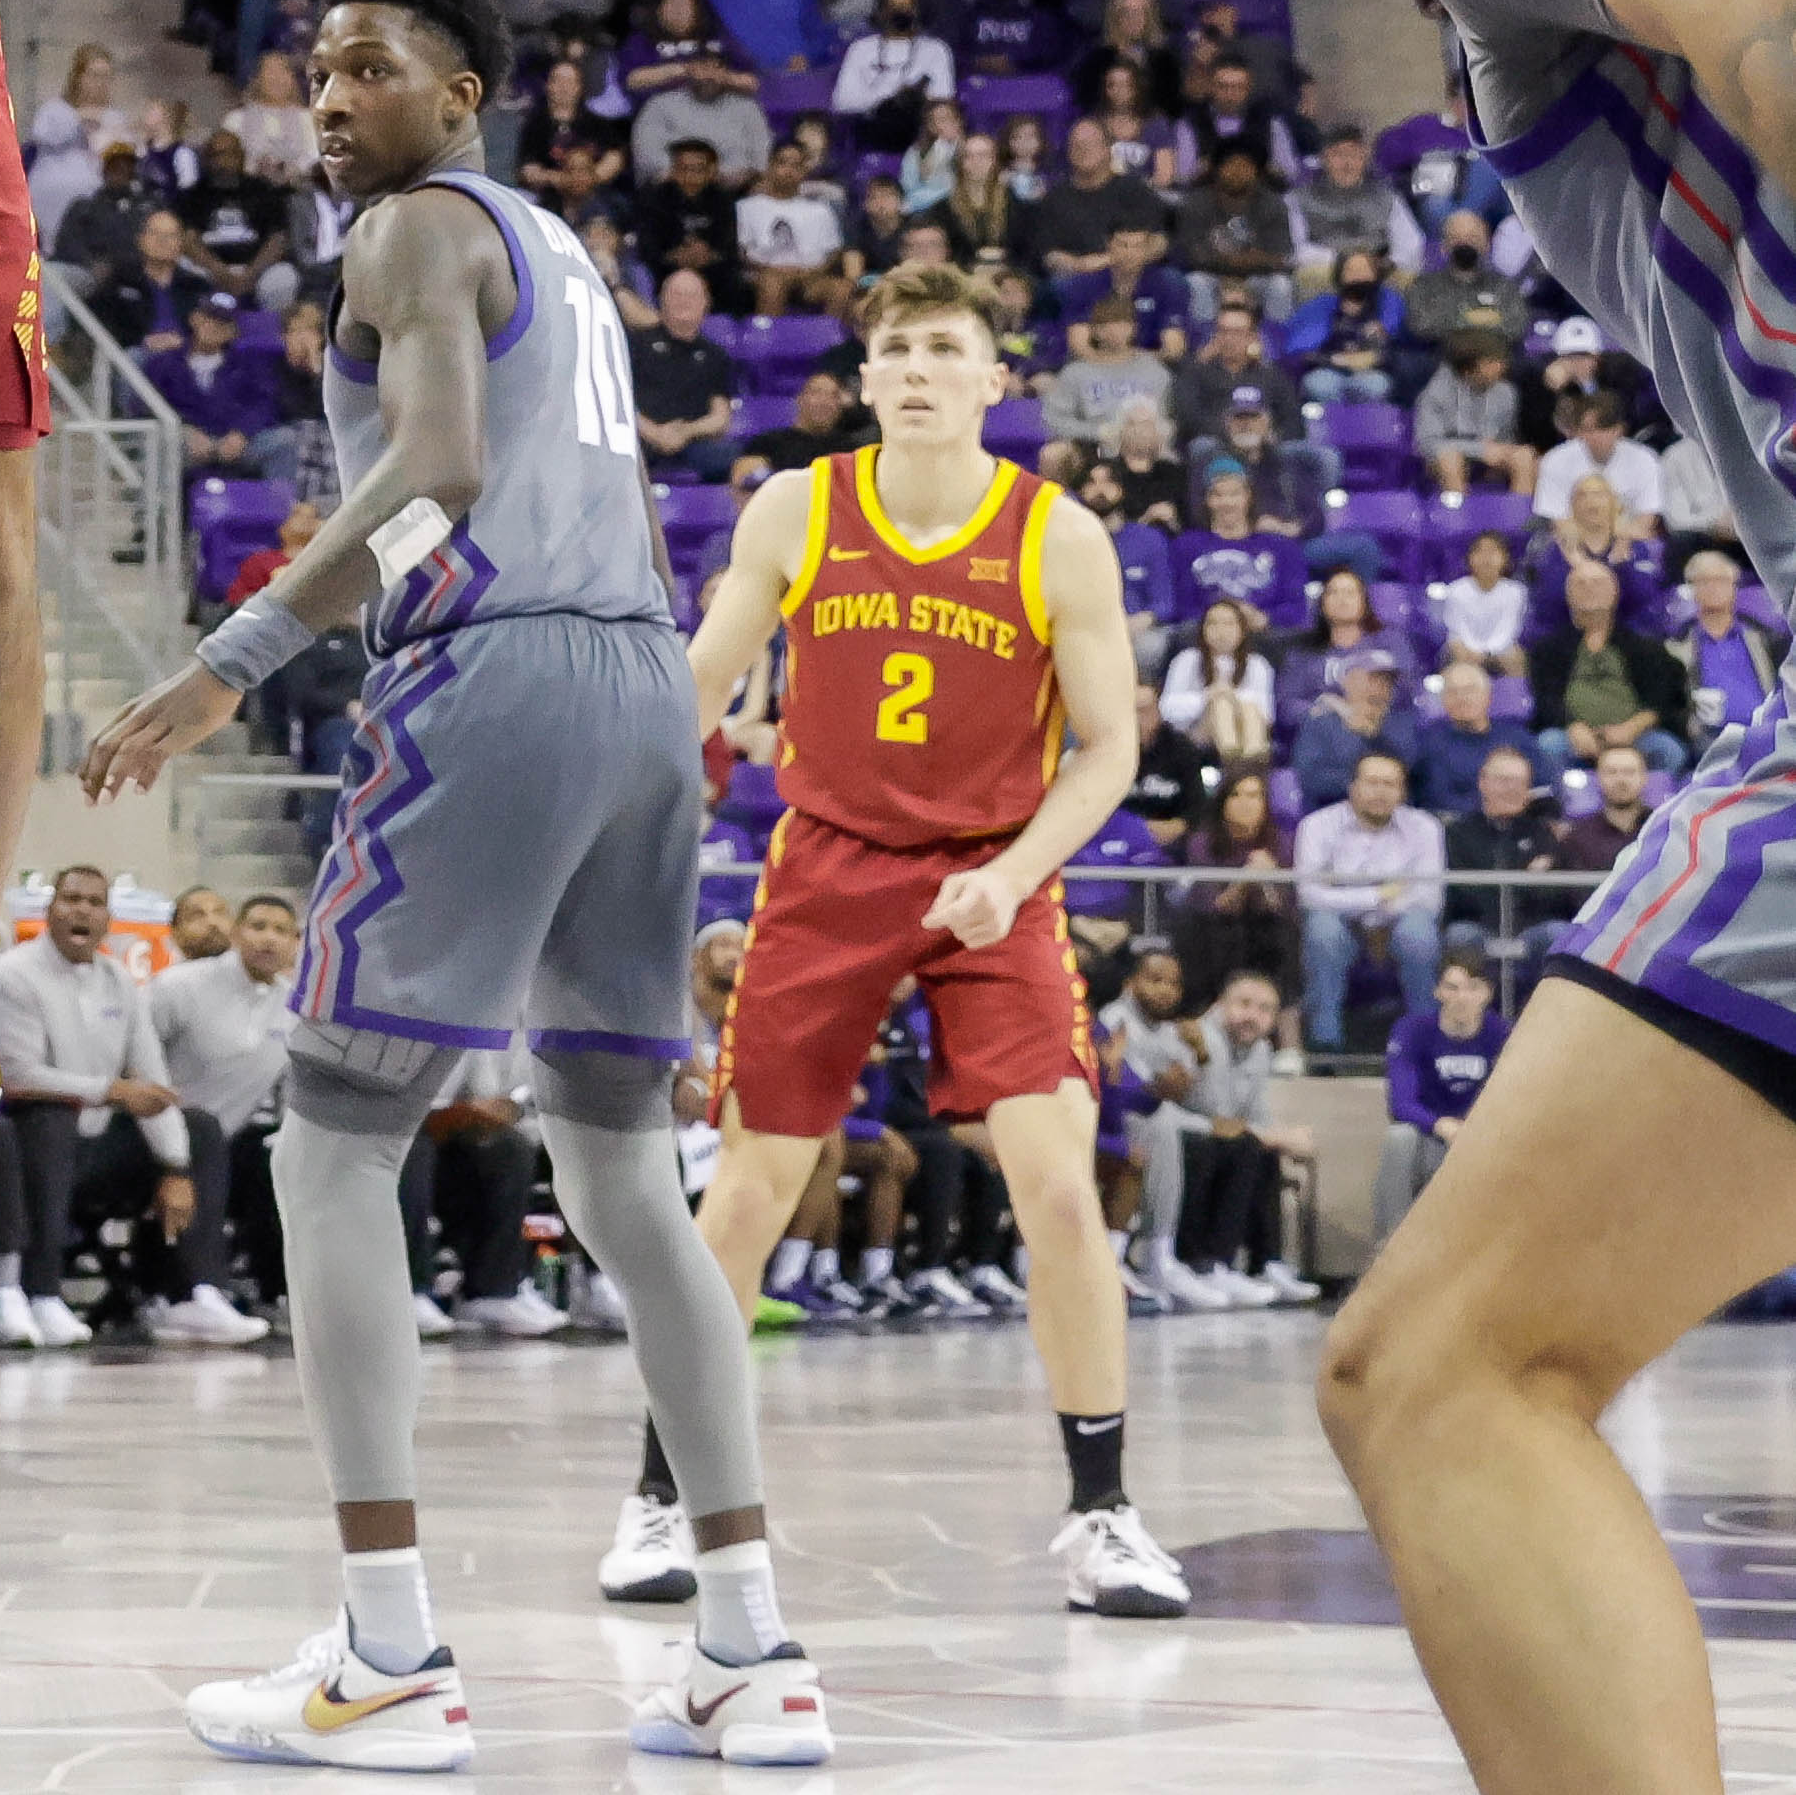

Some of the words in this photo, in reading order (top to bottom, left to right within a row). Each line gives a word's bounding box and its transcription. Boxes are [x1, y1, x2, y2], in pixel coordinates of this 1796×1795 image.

[564, 274, 636, 458] 10
[813, 591, 899, 638] IOWA
[908, 594, 1018, 660] STATE
[876, 651, 935, 745] 2
